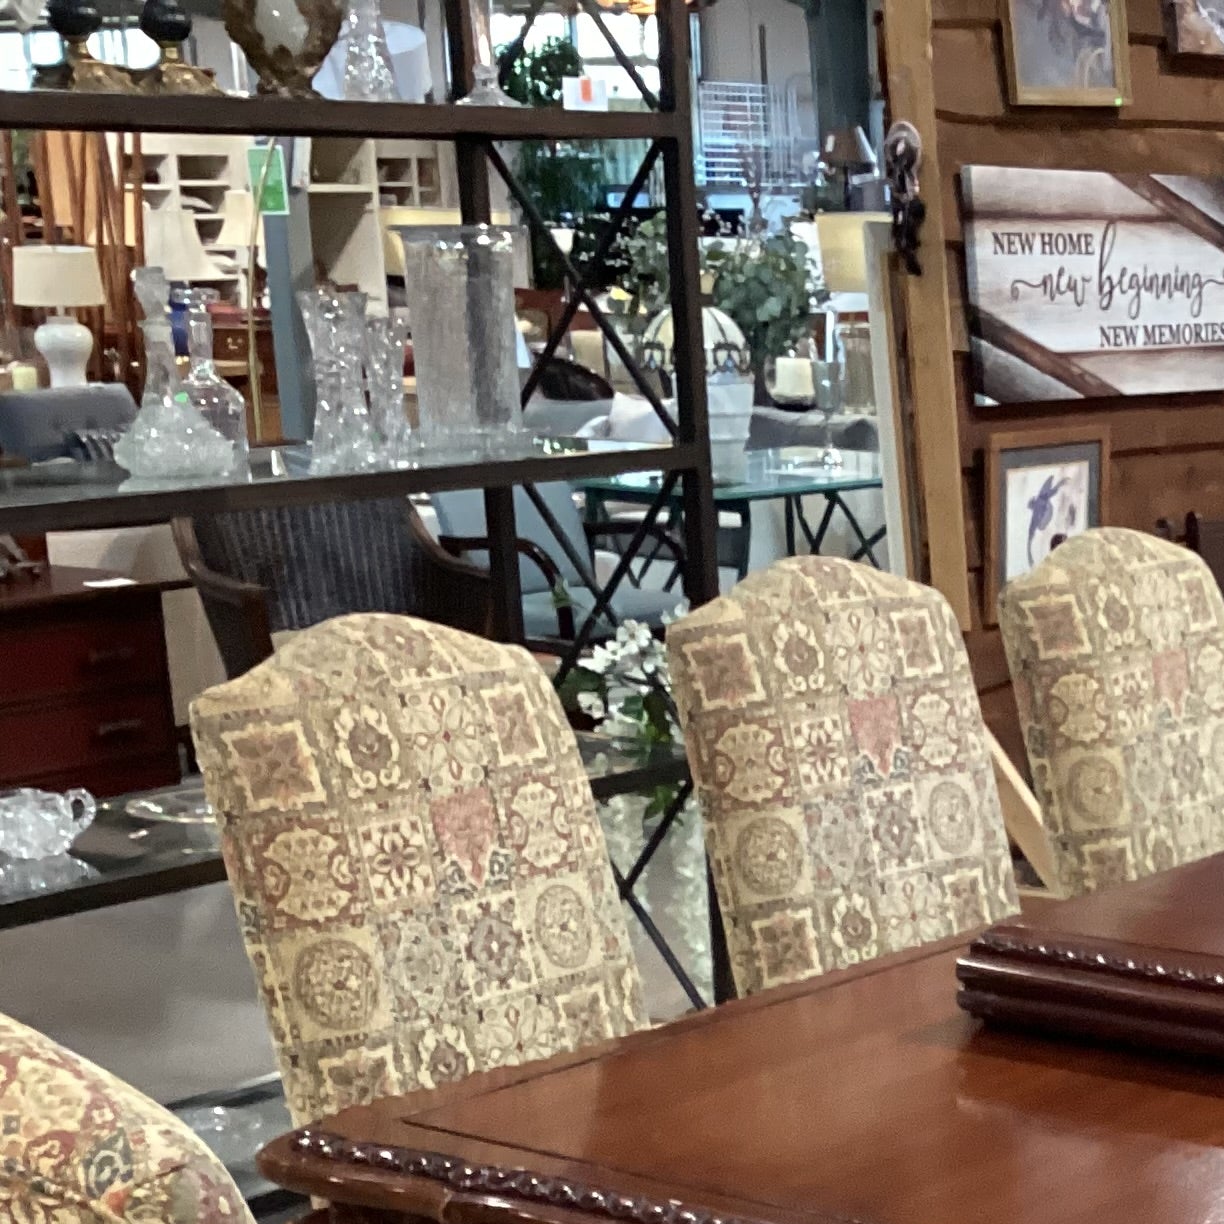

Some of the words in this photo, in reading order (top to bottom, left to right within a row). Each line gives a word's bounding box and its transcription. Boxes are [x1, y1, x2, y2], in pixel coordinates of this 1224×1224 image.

[993, 232, 1036, 256] NEW
[1040, 233, 1095, 256] HOME
[1011, 266, 1091, 306] new
[1099, 325, 1141, 348] NEW
